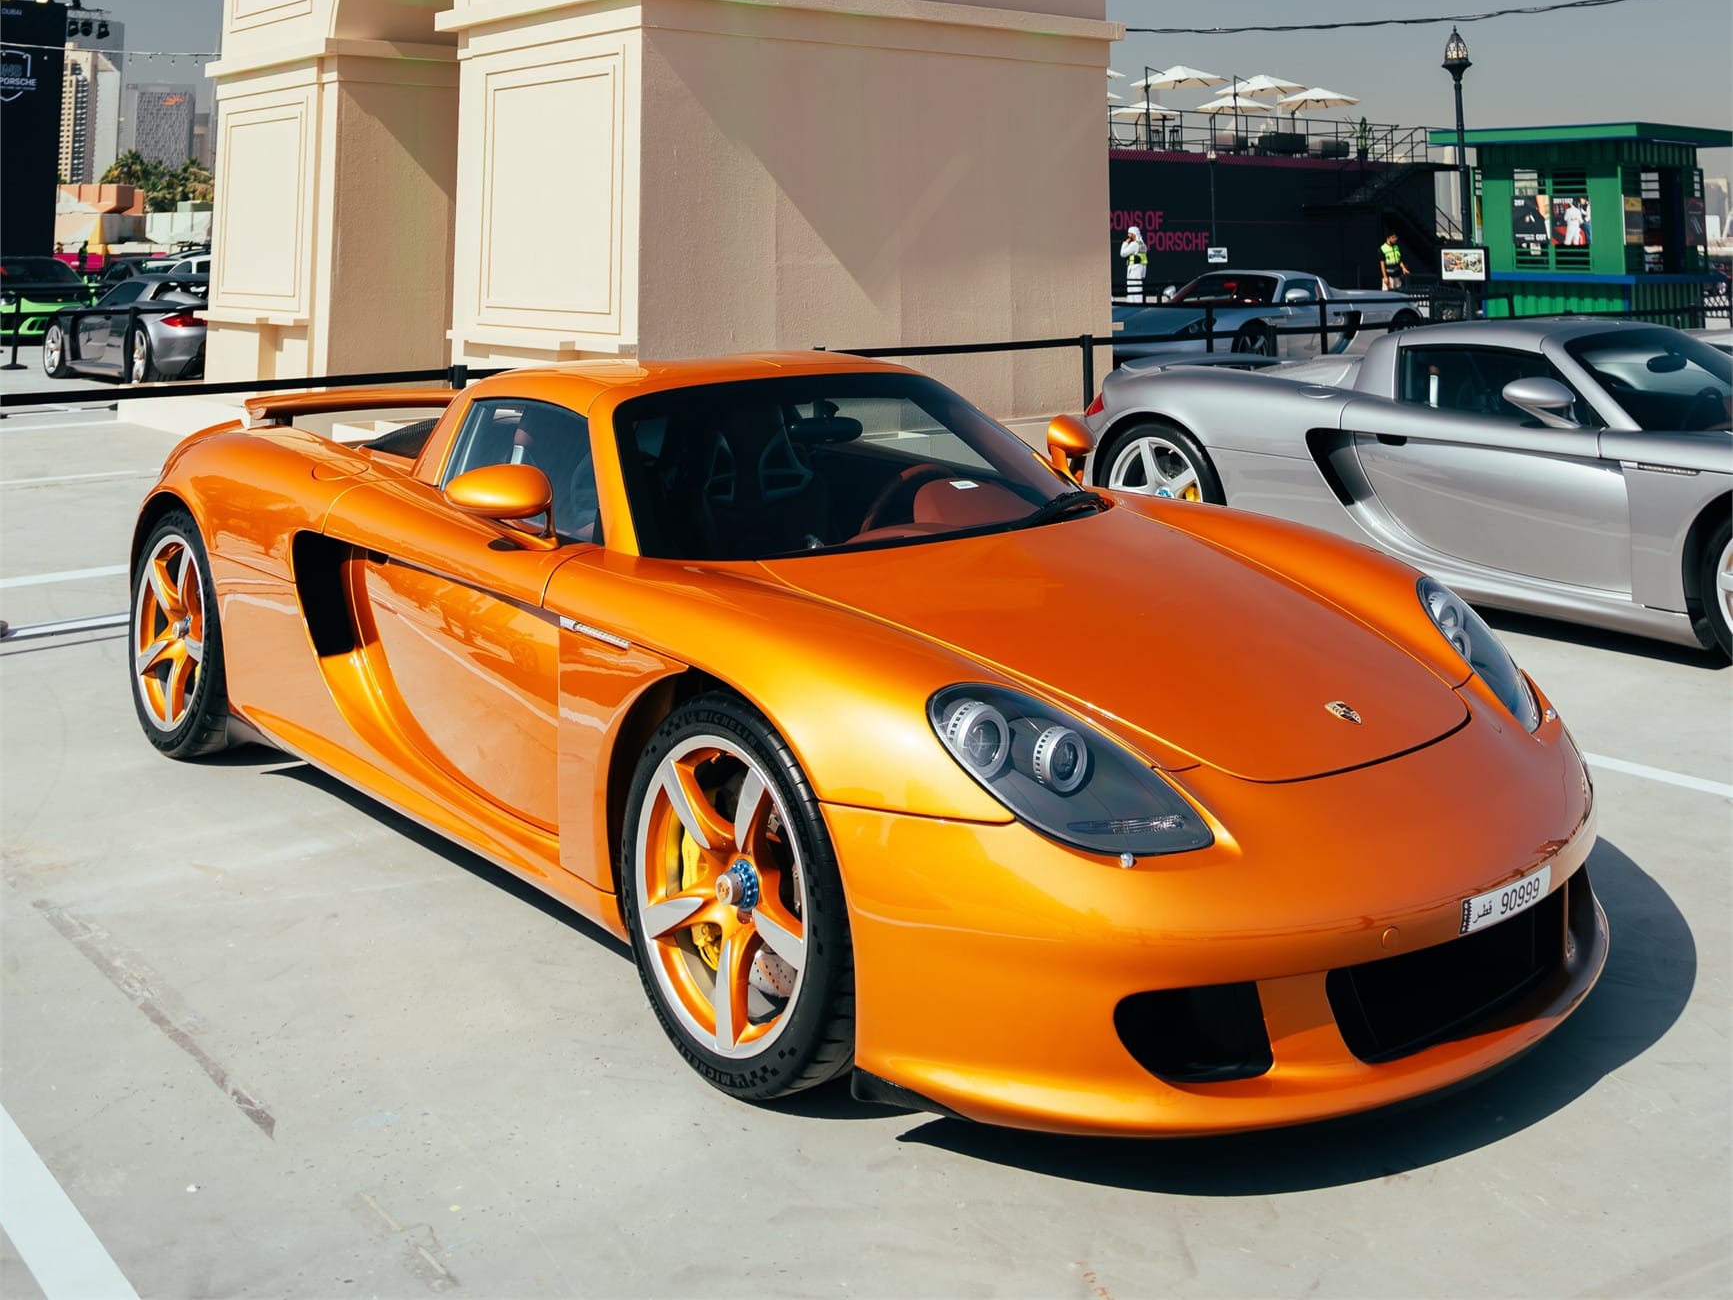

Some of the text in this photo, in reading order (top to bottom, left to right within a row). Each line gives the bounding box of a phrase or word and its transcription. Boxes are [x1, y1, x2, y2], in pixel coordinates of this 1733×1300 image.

[1145, 210, 1164, 231] OF
[698, 710, 758, 747] MICHELIN
[1472, 900, 1492, 924] قطر
[1500, 877, 1540, 915] 90999
[672, 1035, 731, 1086] MICHELIN
